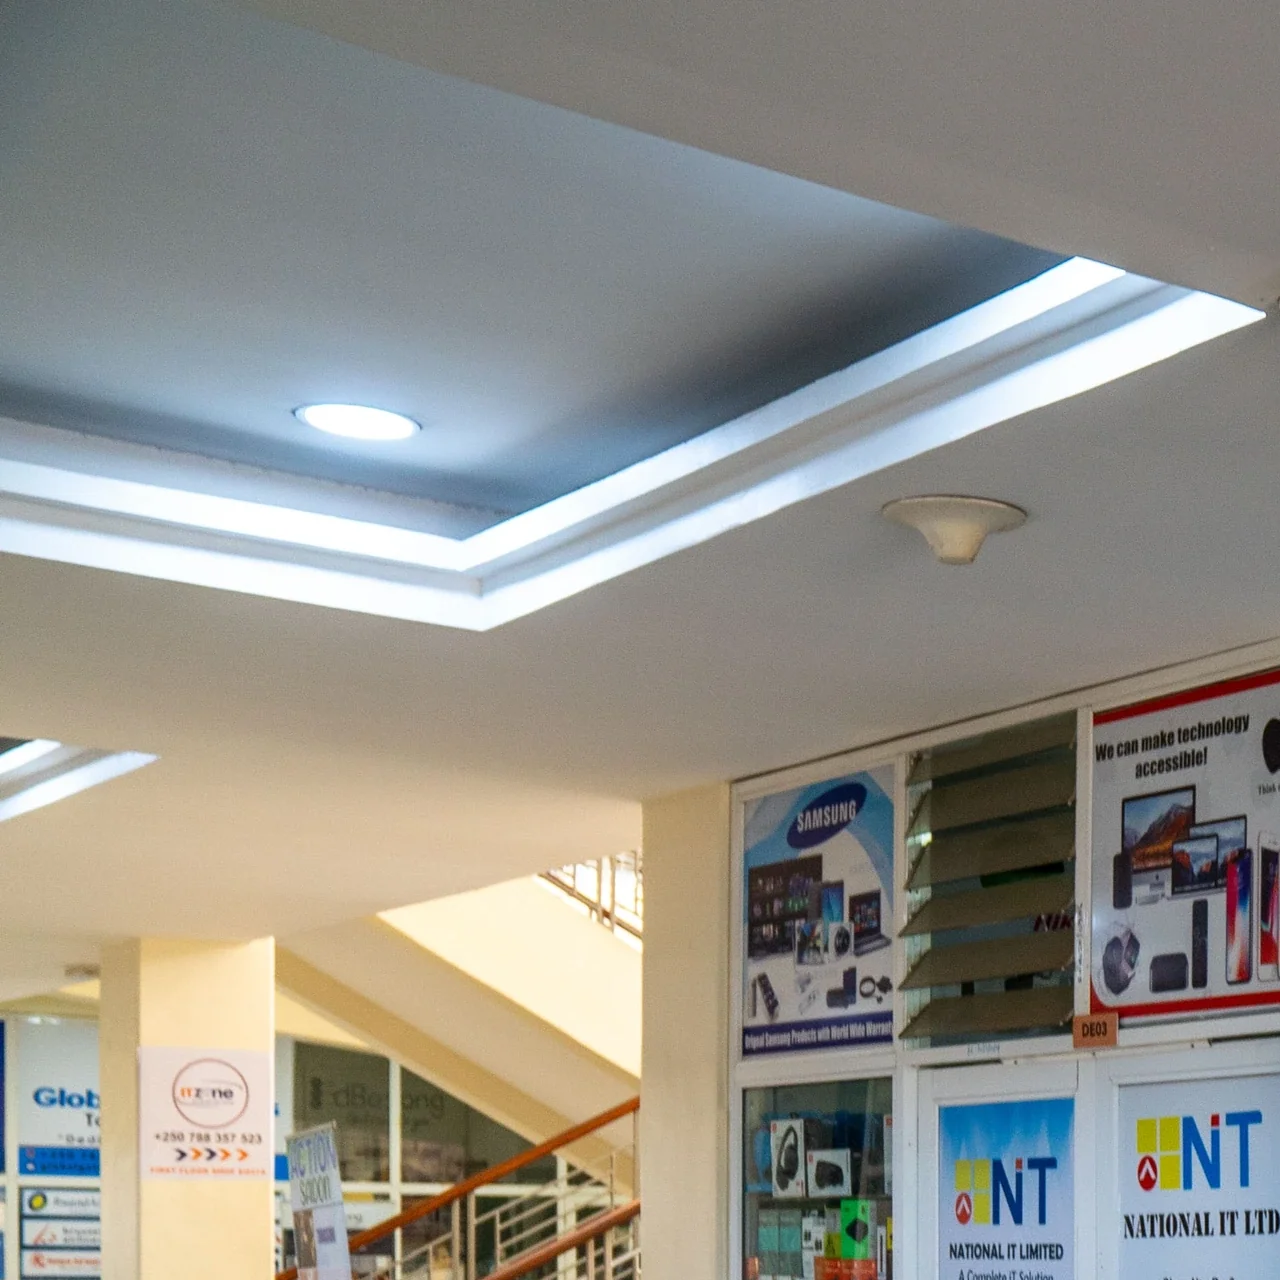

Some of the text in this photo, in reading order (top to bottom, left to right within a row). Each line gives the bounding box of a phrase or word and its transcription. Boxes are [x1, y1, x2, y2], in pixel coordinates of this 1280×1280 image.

[1095, 713, 1250, 762] We can make technology
[1135, 746, 1209, 779] accessible!
[796, 797, 857, 834] SAMSUNG
[1081, 1021, 1108, 1038] DE03
[154, 1132, 186, 1143] +250
[1123, 1208, 1280, 1239] NATIONAL IT LTD
[949, 1242, 1064, 1261] NATIONAL IT LIMITED
